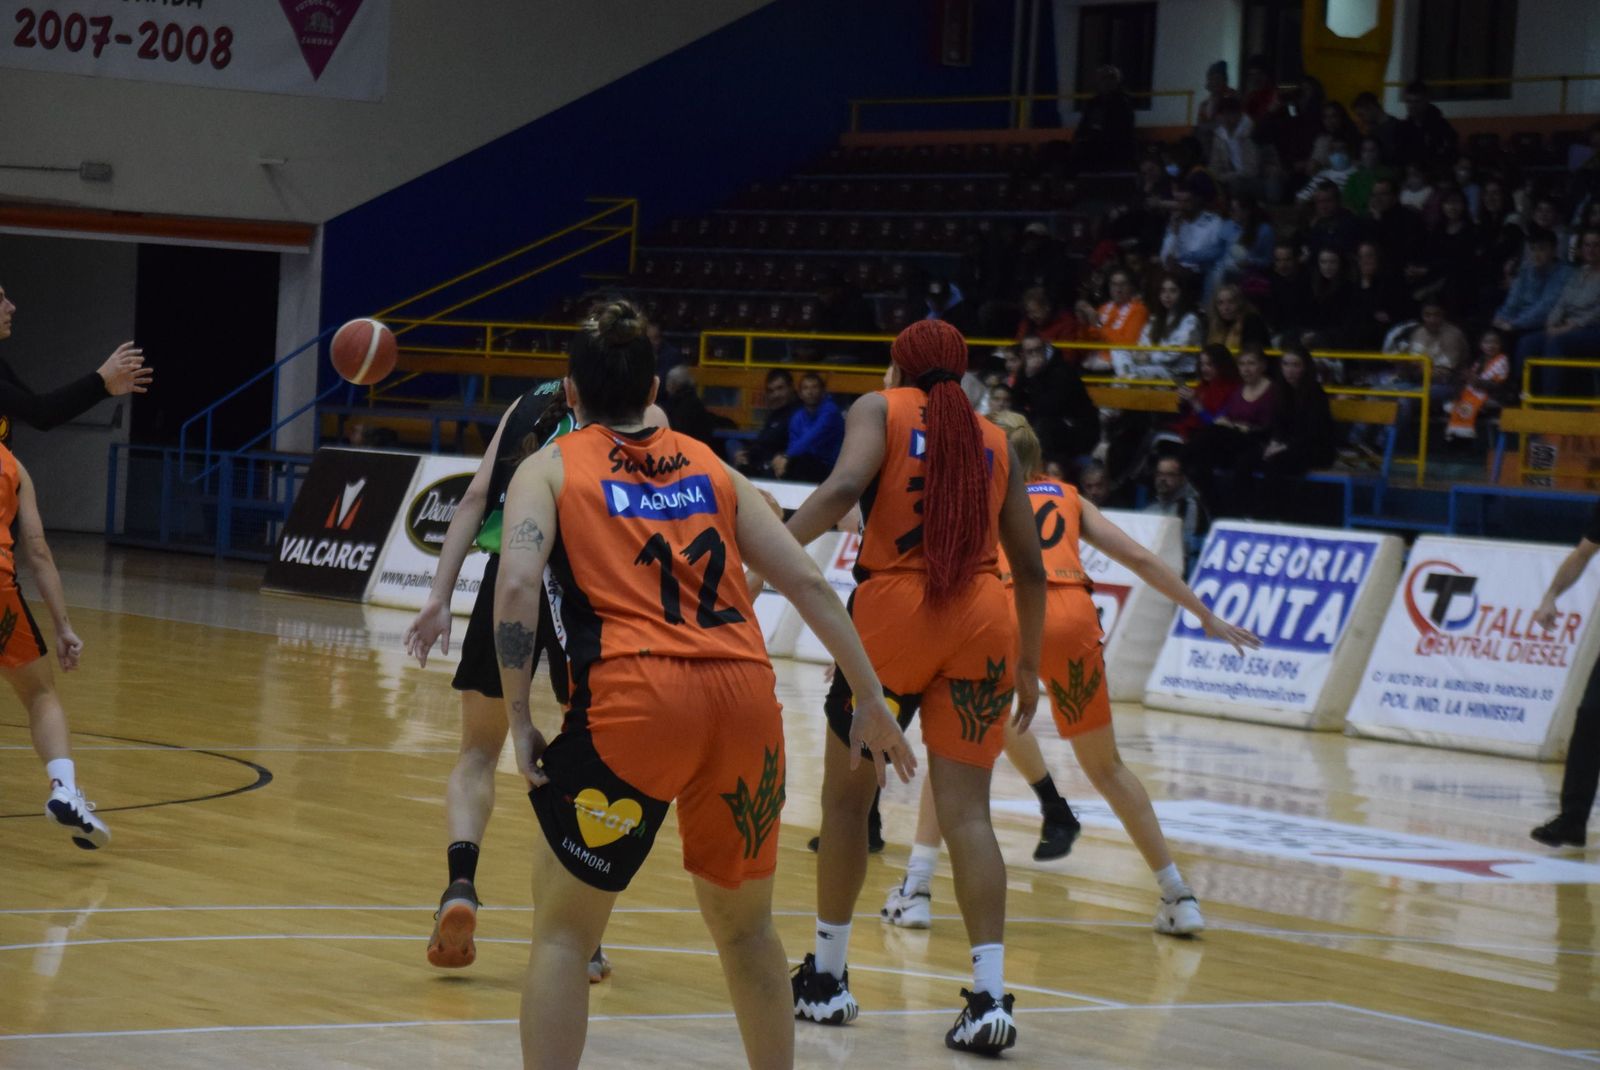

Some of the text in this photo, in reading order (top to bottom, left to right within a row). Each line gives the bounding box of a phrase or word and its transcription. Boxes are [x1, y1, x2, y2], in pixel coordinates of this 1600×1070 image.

[13, 8, 234, 70] 2007-2008
[639, 485, 707, 511] AQUNA
[278, 536, 376, 572] VALCARCE
[1202, 538, 1365, 584] ASESORIA
[634, 526, 747, 629] 12
[1181, 578, 1346, 645] CONTA
[1475, 604, 1583, 645] TALLER
[1506, 641, 1568, 668] DIESEL
